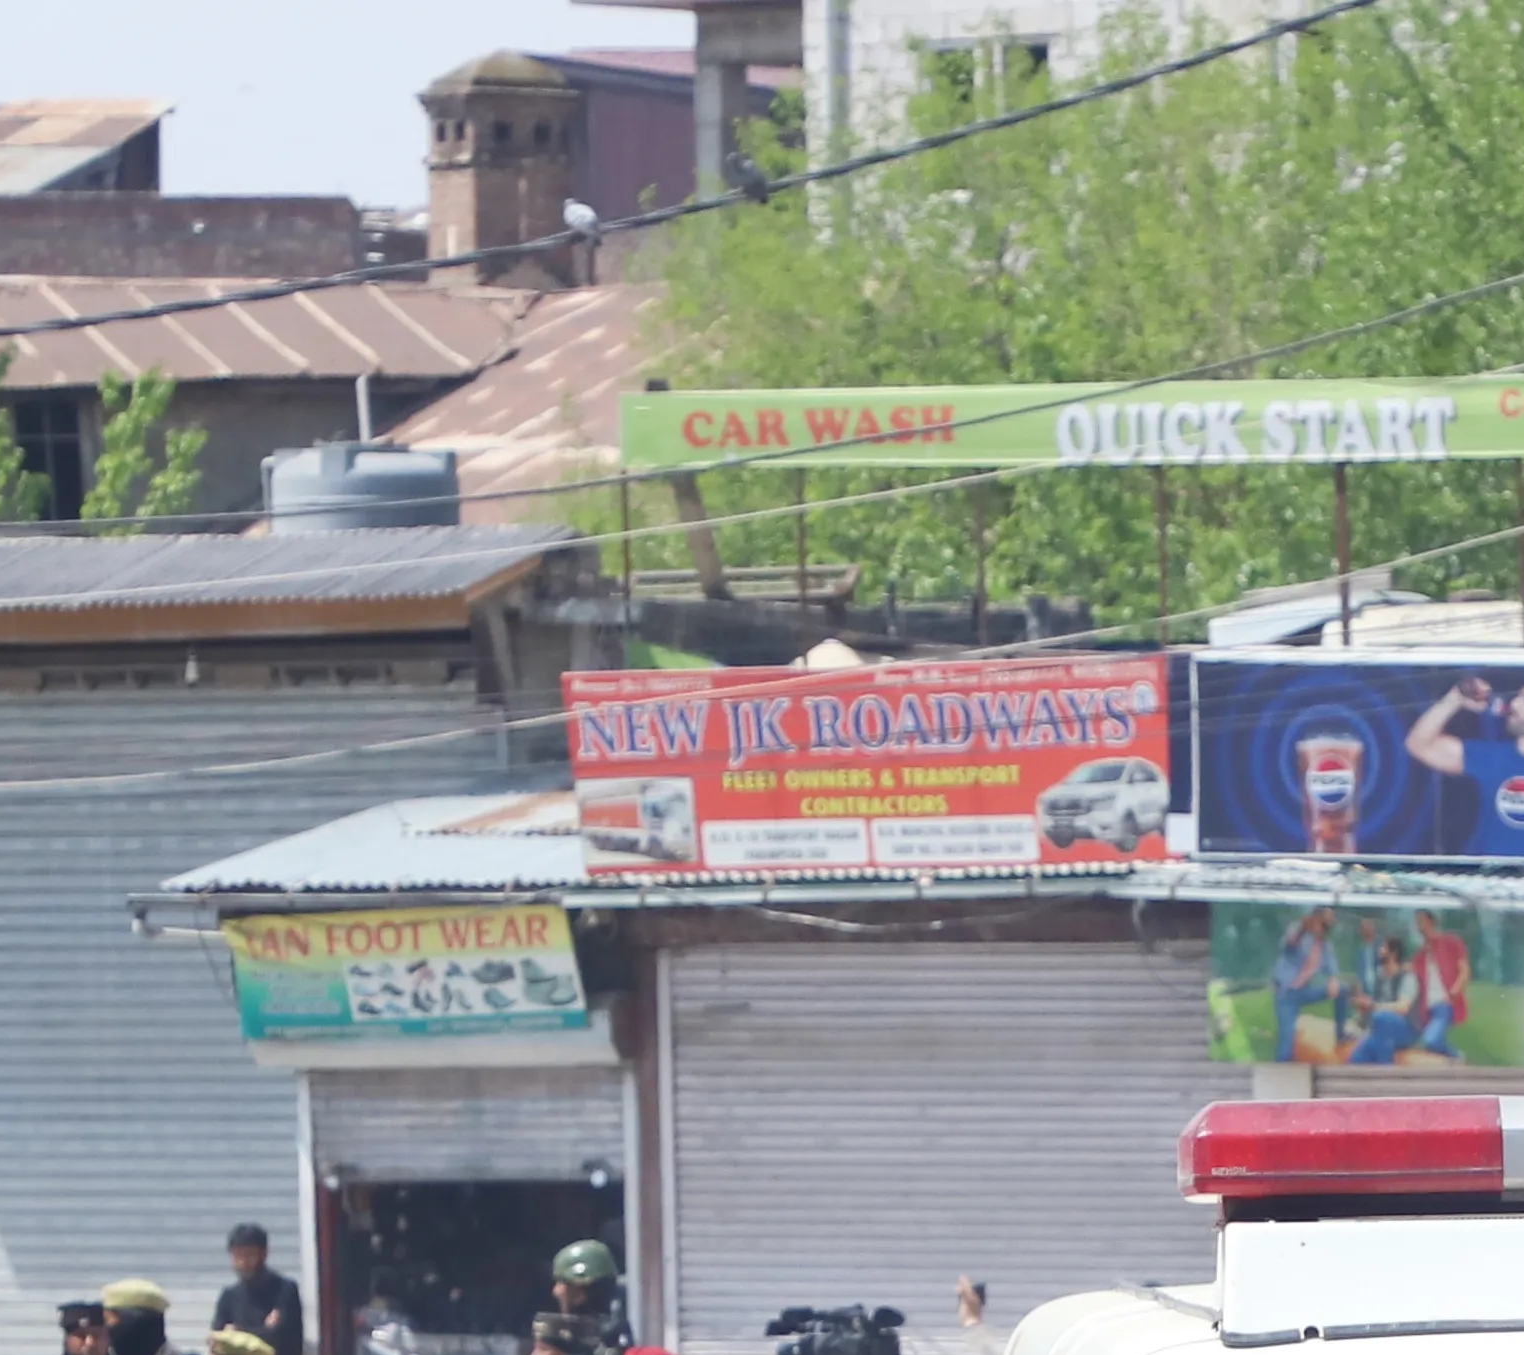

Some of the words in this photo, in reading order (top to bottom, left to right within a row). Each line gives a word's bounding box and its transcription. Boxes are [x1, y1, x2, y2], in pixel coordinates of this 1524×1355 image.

[682, 410, 790, 448] CAR
[806, 404, 955, 447] WASH
[1055, 399, 1250, 467] QUICK
[1262, 395, 1458, 465] START
[575, 698, 708, 761] NEW
[723, 696, 797, 769] JK
[802, 685, 1135, 756] ROADWAYS
[722, 770, 778, 792] FLEET
[784, 768, 874, 790] OWNERS
[880, 767, 895, 788] &
[902, 764, 1021, 787] TRANSPORT
[800, 794, 949, 816] CONTRACTORS
[325, 920, 423, 957] FOOT
[438, 913, 550, 950] WEAR
